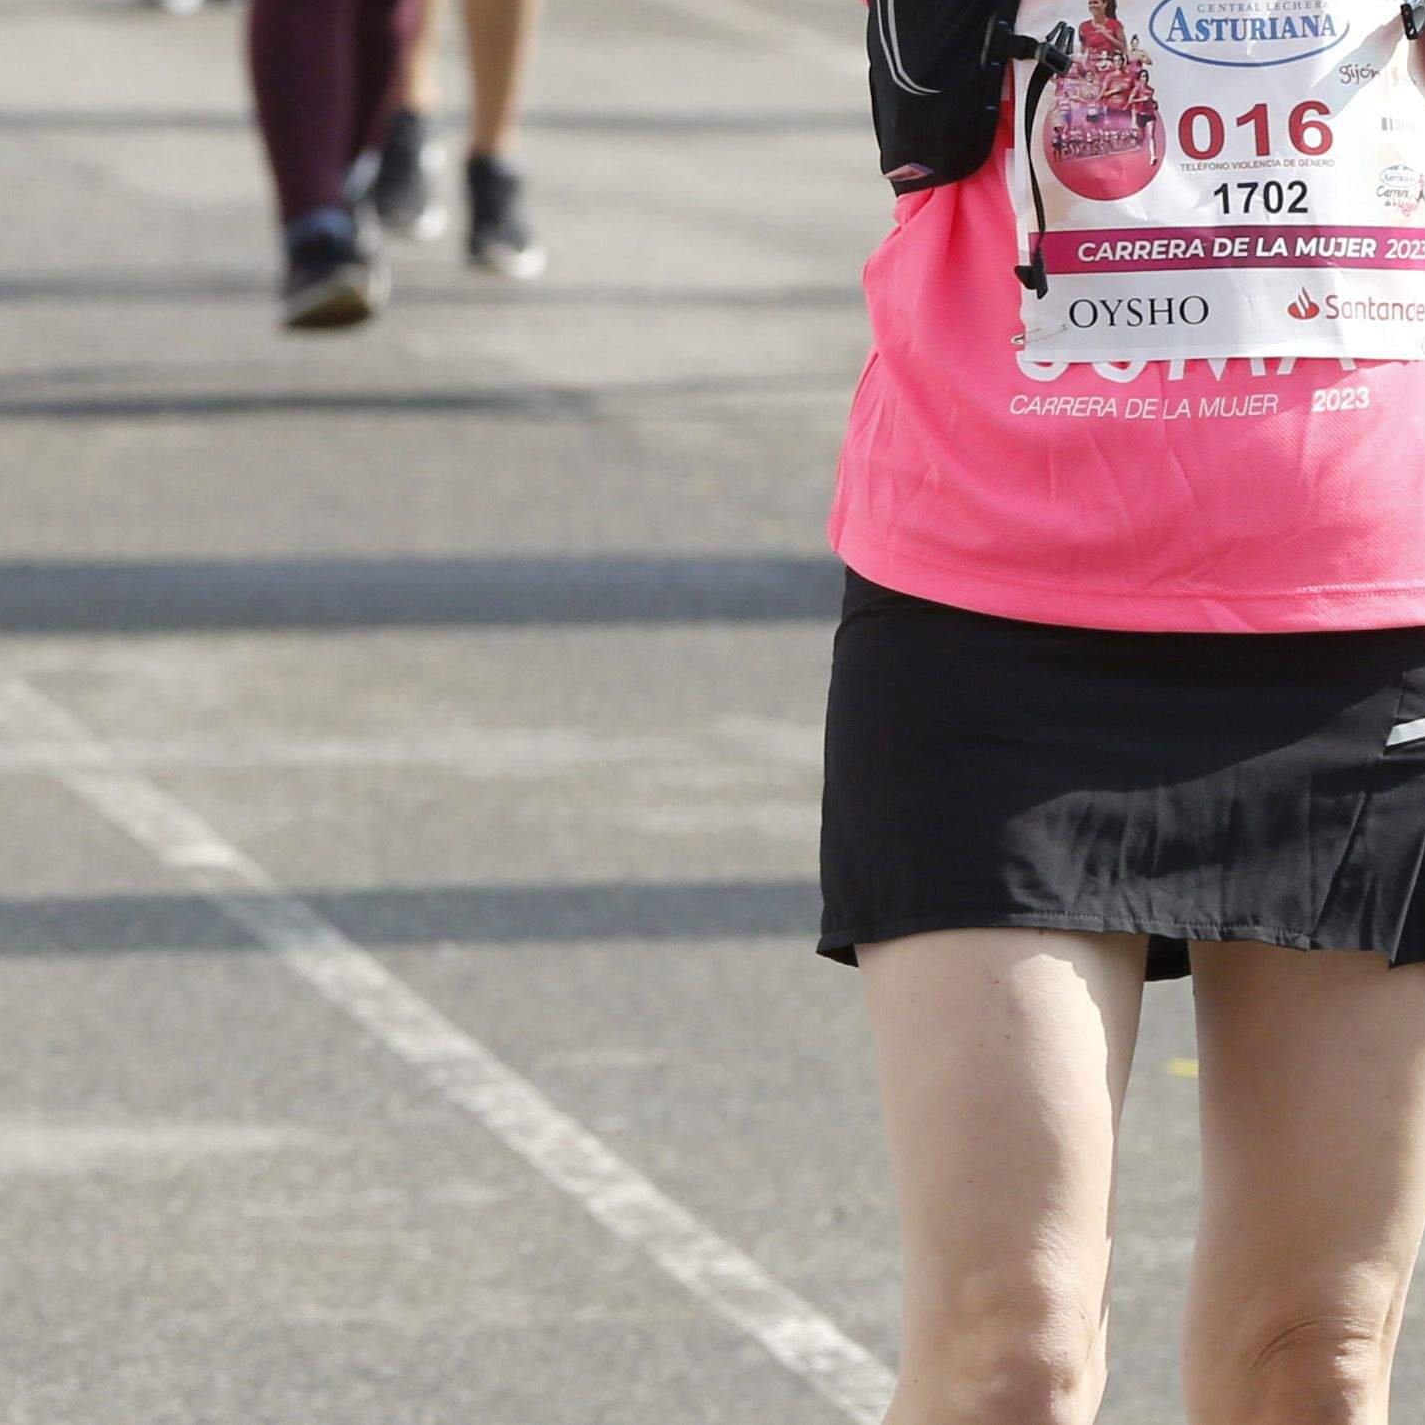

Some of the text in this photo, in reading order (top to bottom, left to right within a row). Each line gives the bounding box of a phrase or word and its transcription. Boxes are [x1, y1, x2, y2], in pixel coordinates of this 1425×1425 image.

[1165, 6, 1338, 42] ASTURIANA
[1197, 2, 1261, 14] CENTRAL
[1178, 100, 1334, 161] 016
[1231, 158, 1282, 171] VIOLENCIA
[1283, 158, 1296, 168] DE
[1213, 179, 1309, 215] 1702
[1077, 237, 1205, 263] CARRERA
[1212, 236, 1250, 259] DE
[1255, 236, 1289, 258] LA
[1295, 236, 1377, 259] MUJER
[1069, 294, 1210, 329] OYSHO
[1009, 385, 1372, 420] CARRERA DE LA MUJER 2023
